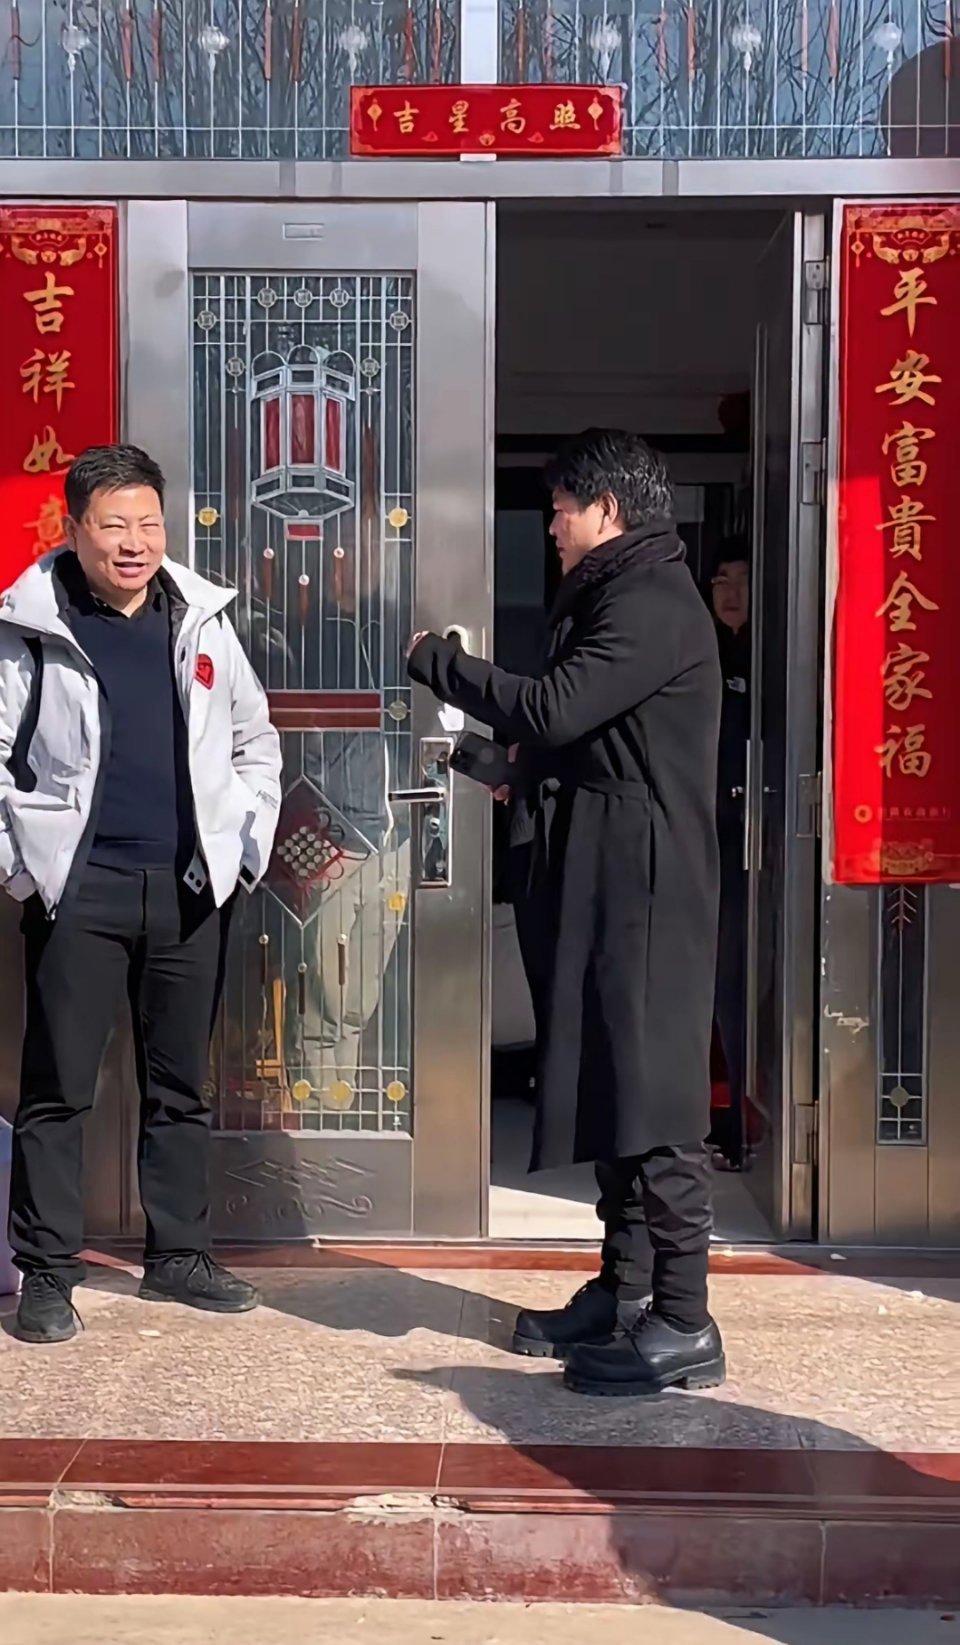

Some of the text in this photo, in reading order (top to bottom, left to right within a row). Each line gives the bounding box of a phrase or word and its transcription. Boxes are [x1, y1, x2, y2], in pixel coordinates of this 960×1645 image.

[393, 98, 581, 134] 吉星高照
[873, 266, 942, 778] 平安富貴全家福
